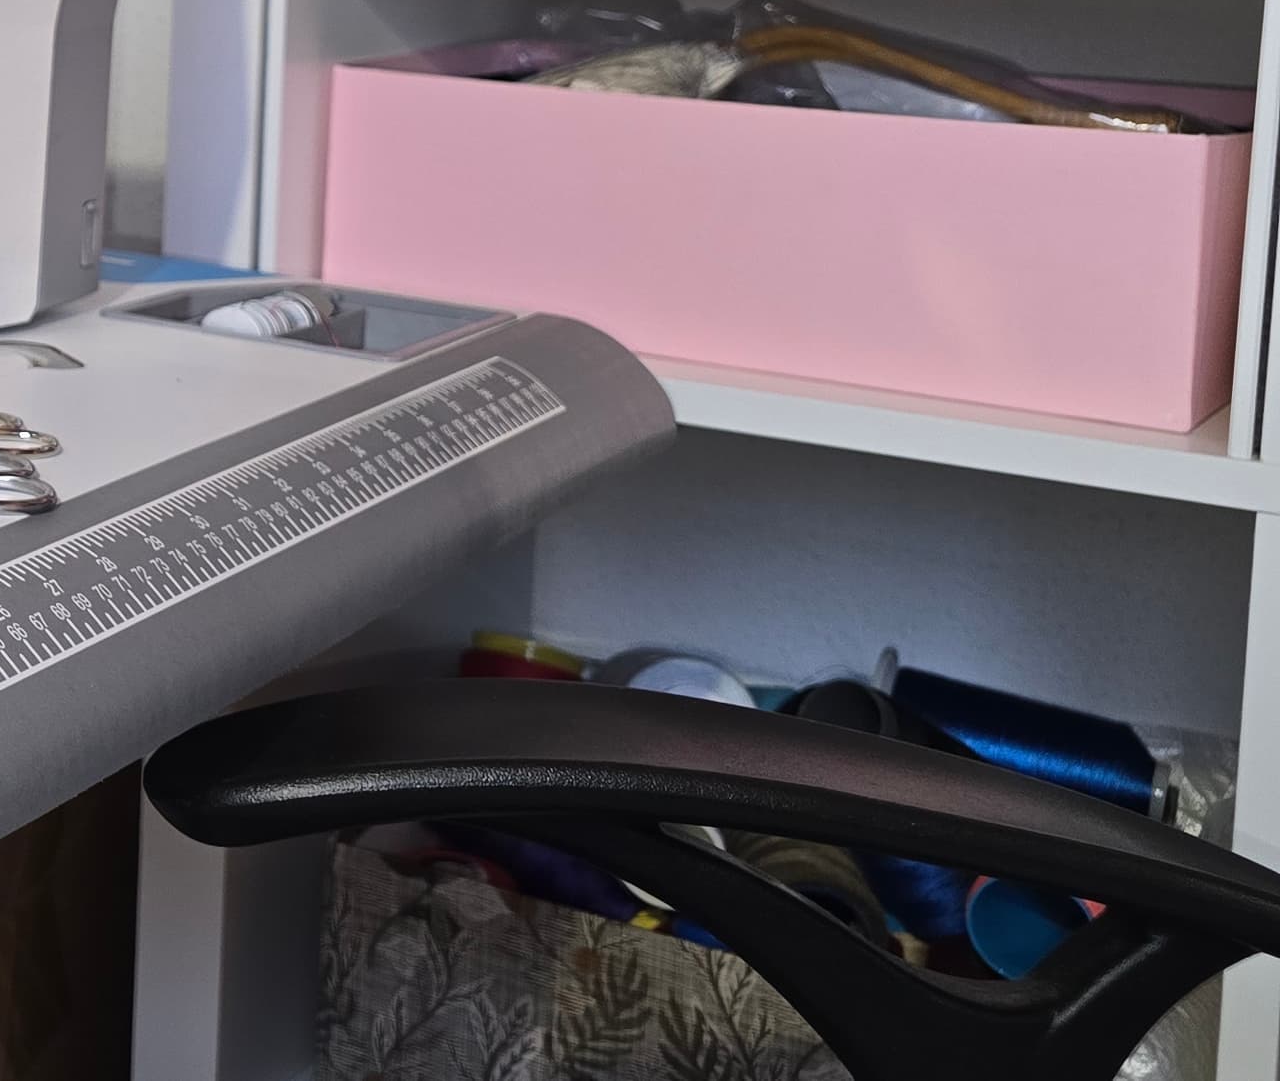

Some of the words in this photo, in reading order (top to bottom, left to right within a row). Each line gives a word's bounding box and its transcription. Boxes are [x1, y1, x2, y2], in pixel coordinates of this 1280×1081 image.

[7, 623, 28, 641] 66
[29, 612, 48, 630] 67
[50, 603, 70, 620] 68
[72, 593, 92, 611] 69
[92, 583, 112, 601] 70
[111, 574, 132, 591] 71
[130, 566, 150, 583] 72
[150, 557, 170, 573] 73
[168, 549, 188, 565] 74
[186, 540, 206, 555] 75
[204, 532, 223, 547] 76
[222, 524, 239, 539] 77
[238, 517, 258, 531] 78
[254, 509, 274, 523] 79
[44, 579, 64, 596] 27
[96, 557, 118, 573] 28
[144, 535, 164, 551] 29
[190, 515, 210, 529] 30
[232, 497, 252, 511] 31
